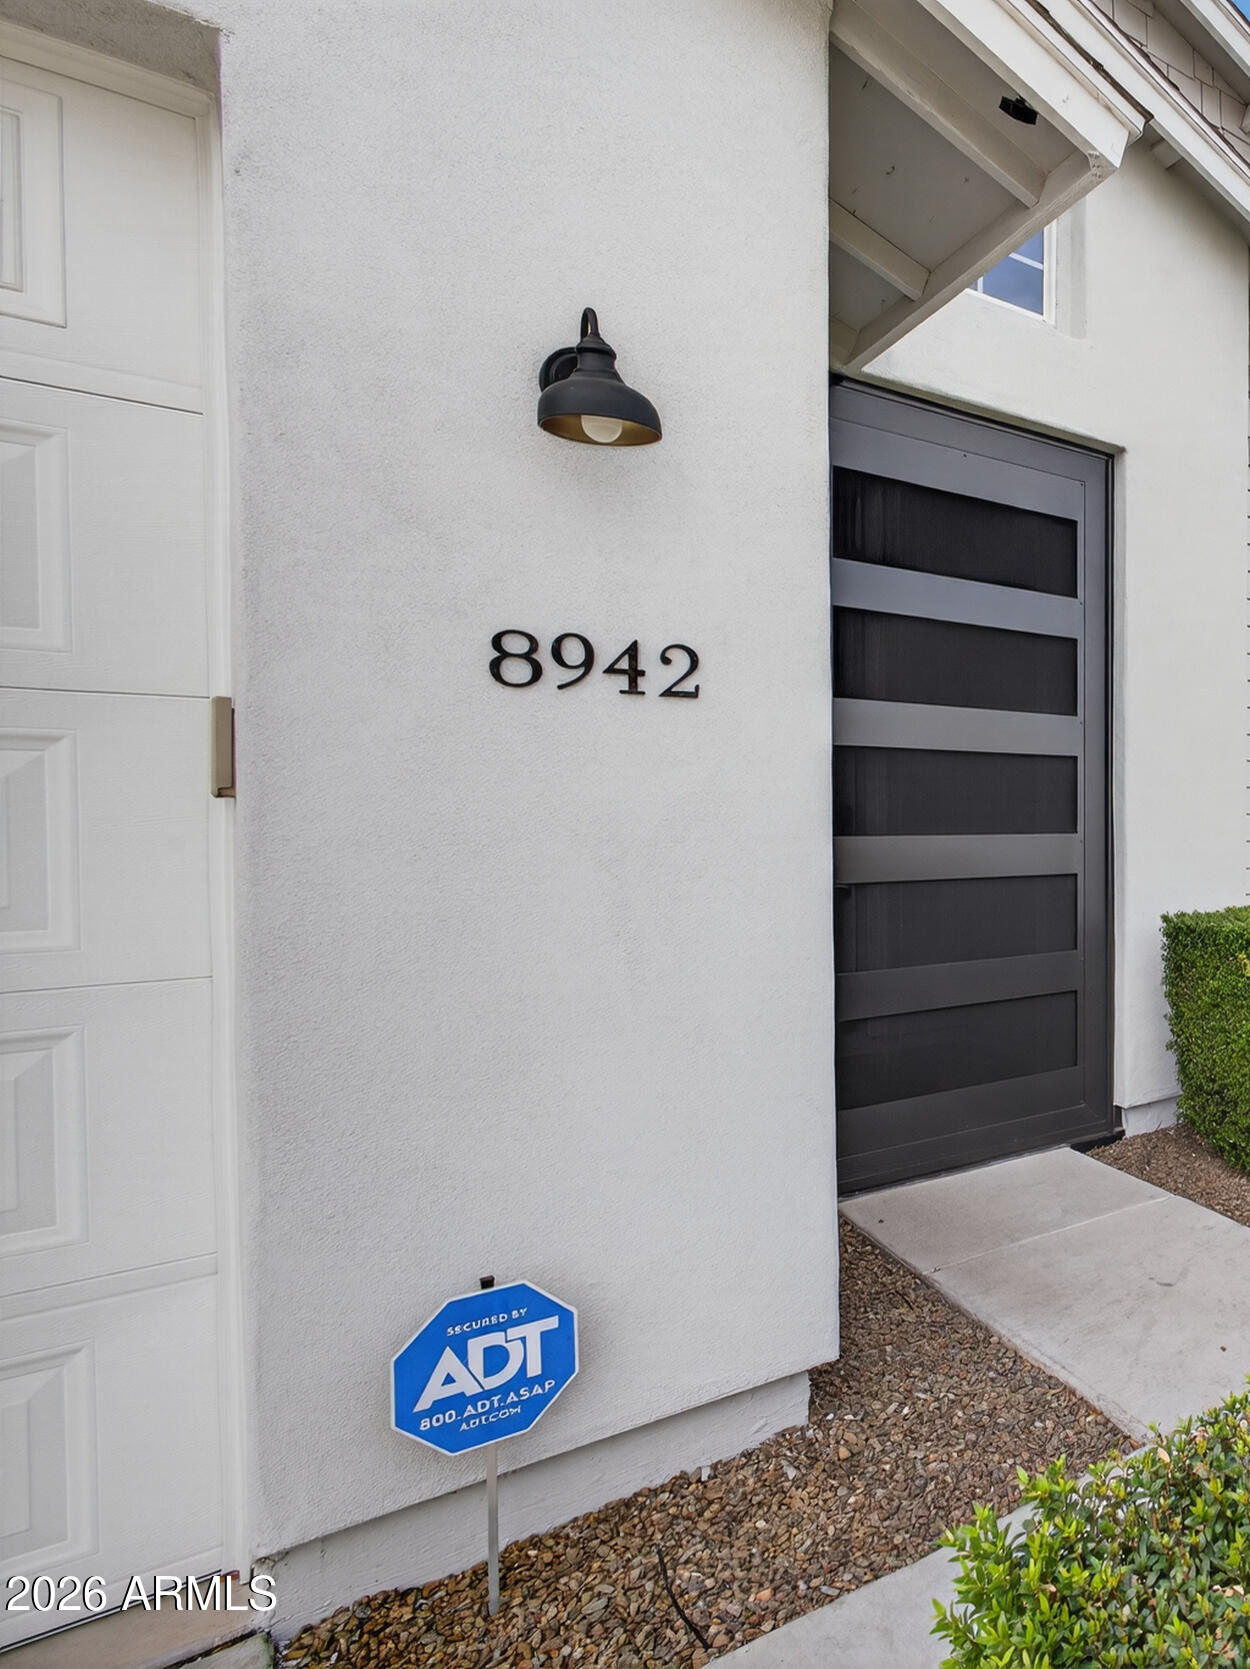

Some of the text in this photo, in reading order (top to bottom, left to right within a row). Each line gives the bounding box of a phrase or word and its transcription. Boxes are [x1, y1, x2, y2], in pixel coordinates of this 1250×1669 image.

[489, 629, 700, 698] 8942
[446, 1307, 528, 1337] SECURED BY
[413, 1315, 559, 1413] ADT
[419, 1379, 556, 1431] 800.ADT.ASAP
